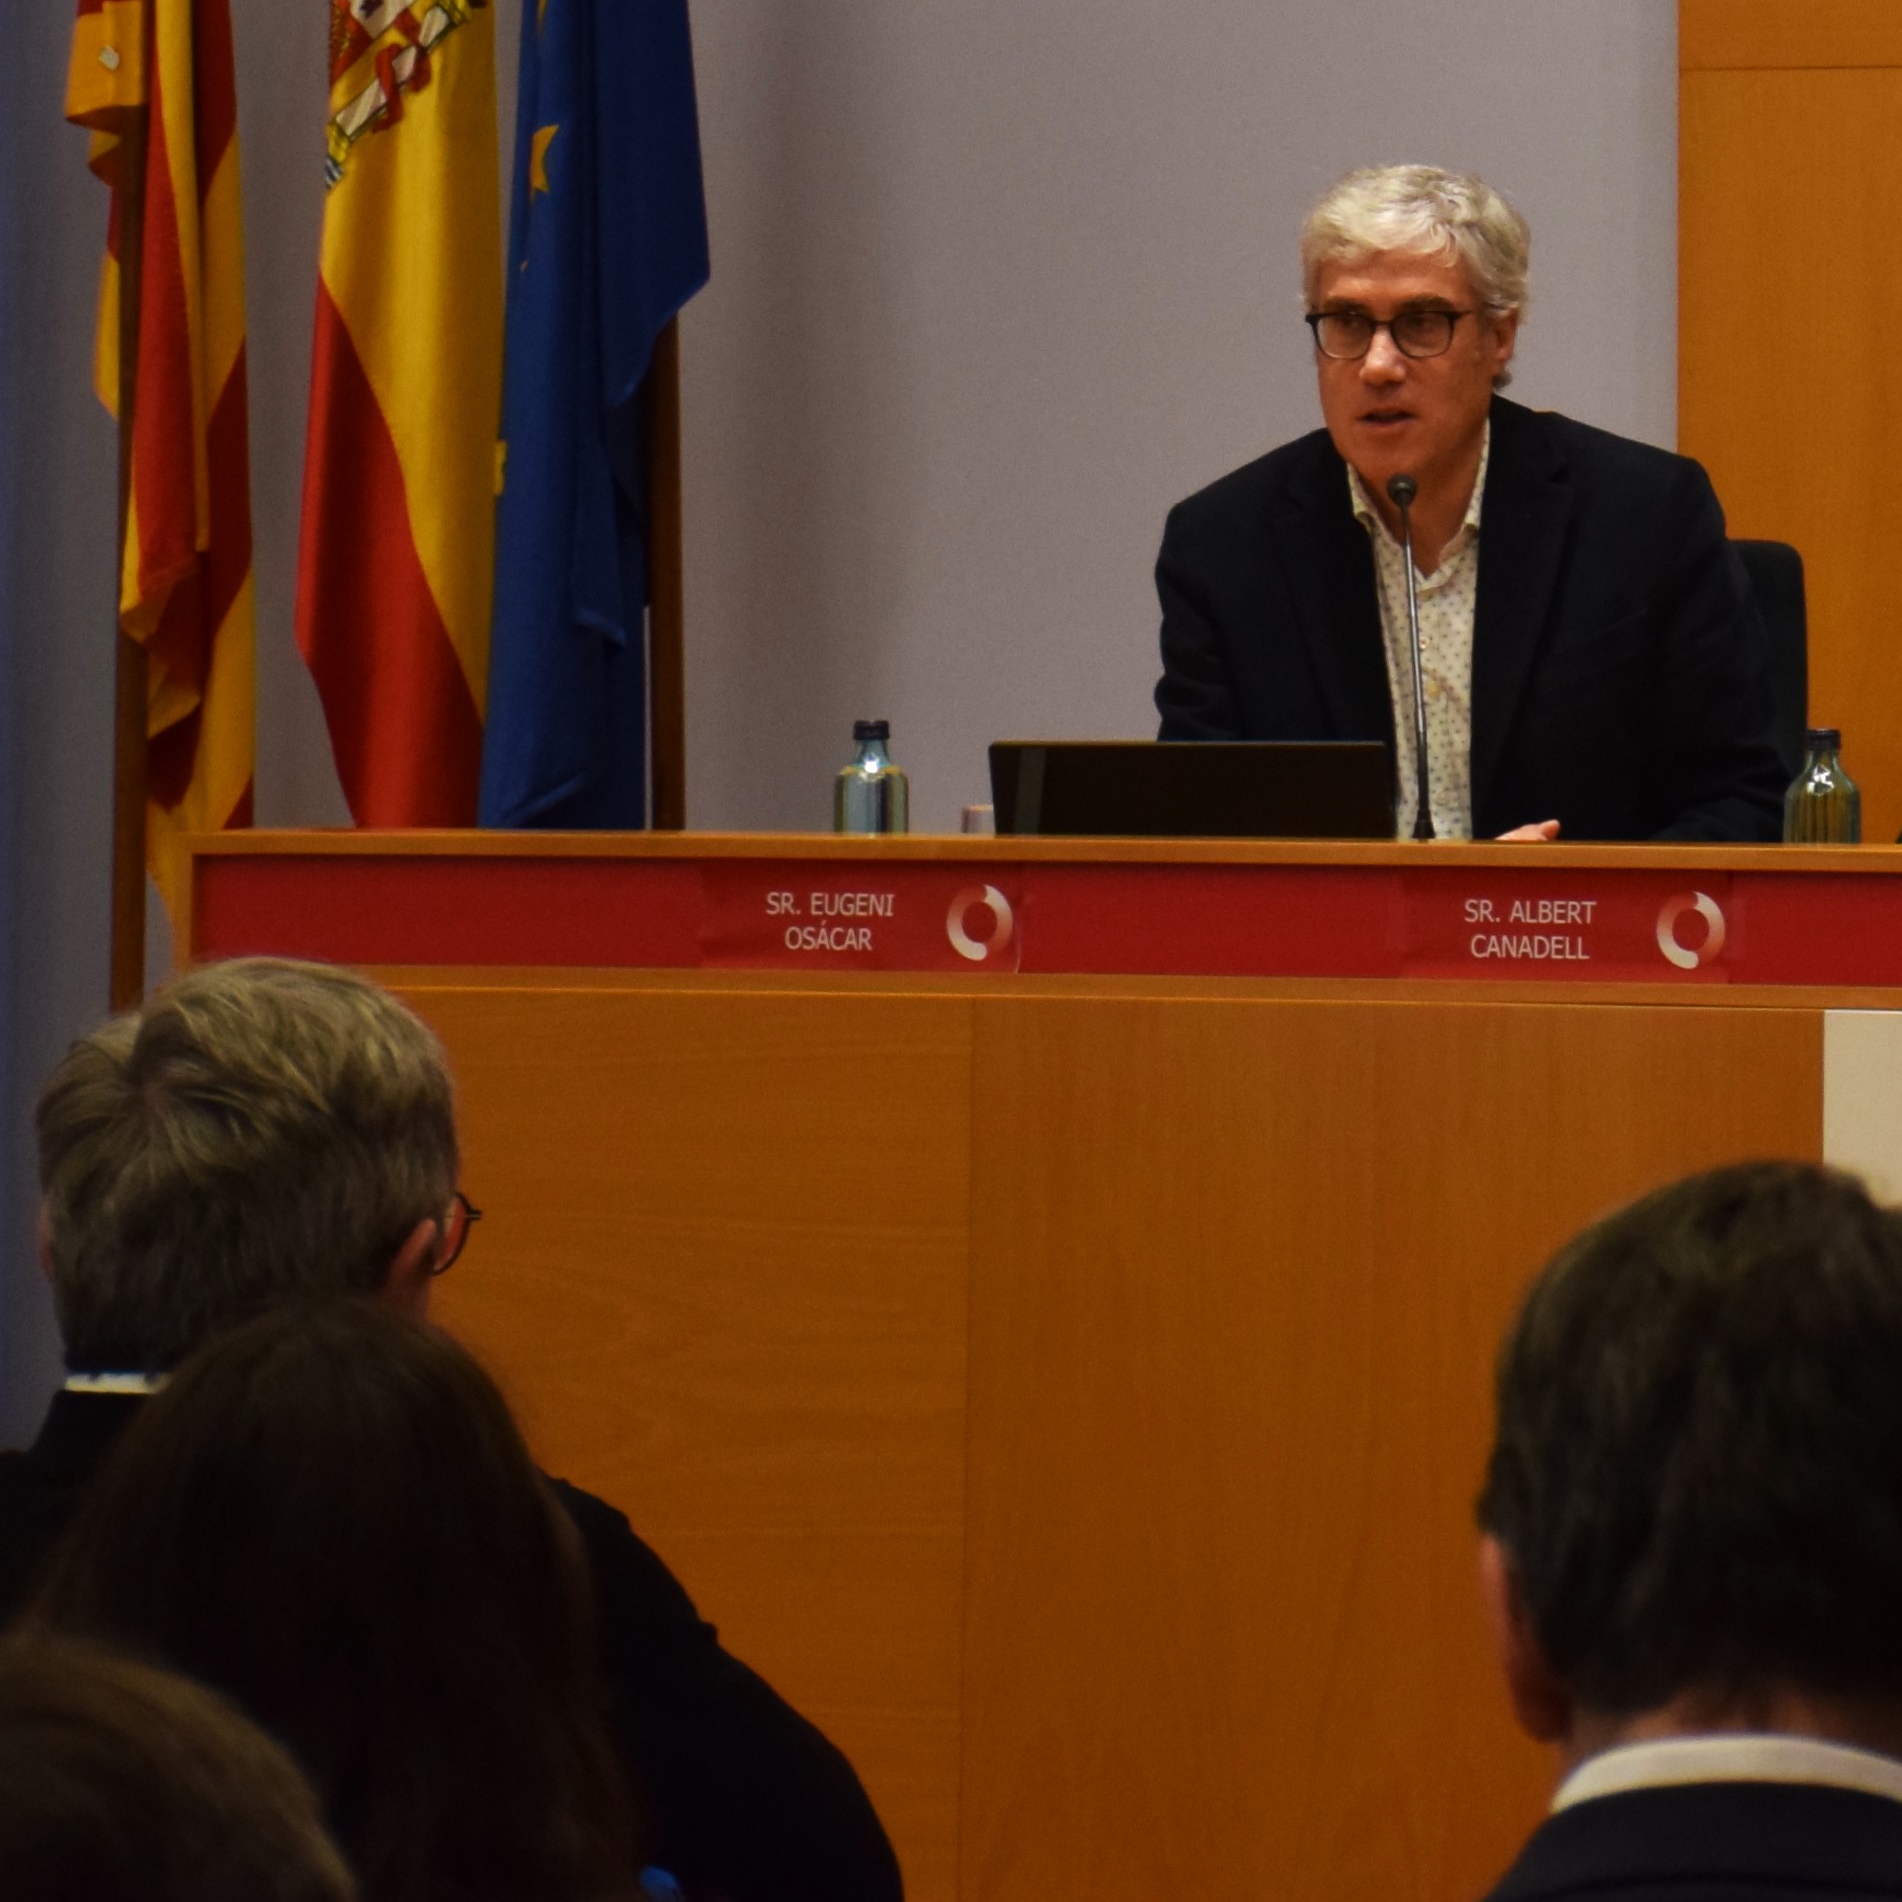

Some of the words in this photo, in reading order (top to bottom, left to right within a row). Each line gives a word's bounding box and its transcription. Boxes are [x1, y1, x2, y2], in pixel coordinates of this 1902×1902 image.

[765, 891, 801, 916] SR.
[810, 892, 895, 917] EUGENI
[1464, 898, 1501, 923] SR.
[1509, 900, 1597, 924] ALBERT
[784, 919, 873, 951] OSÁCAR
[1470, 933, 1590, 960] CANADELL
